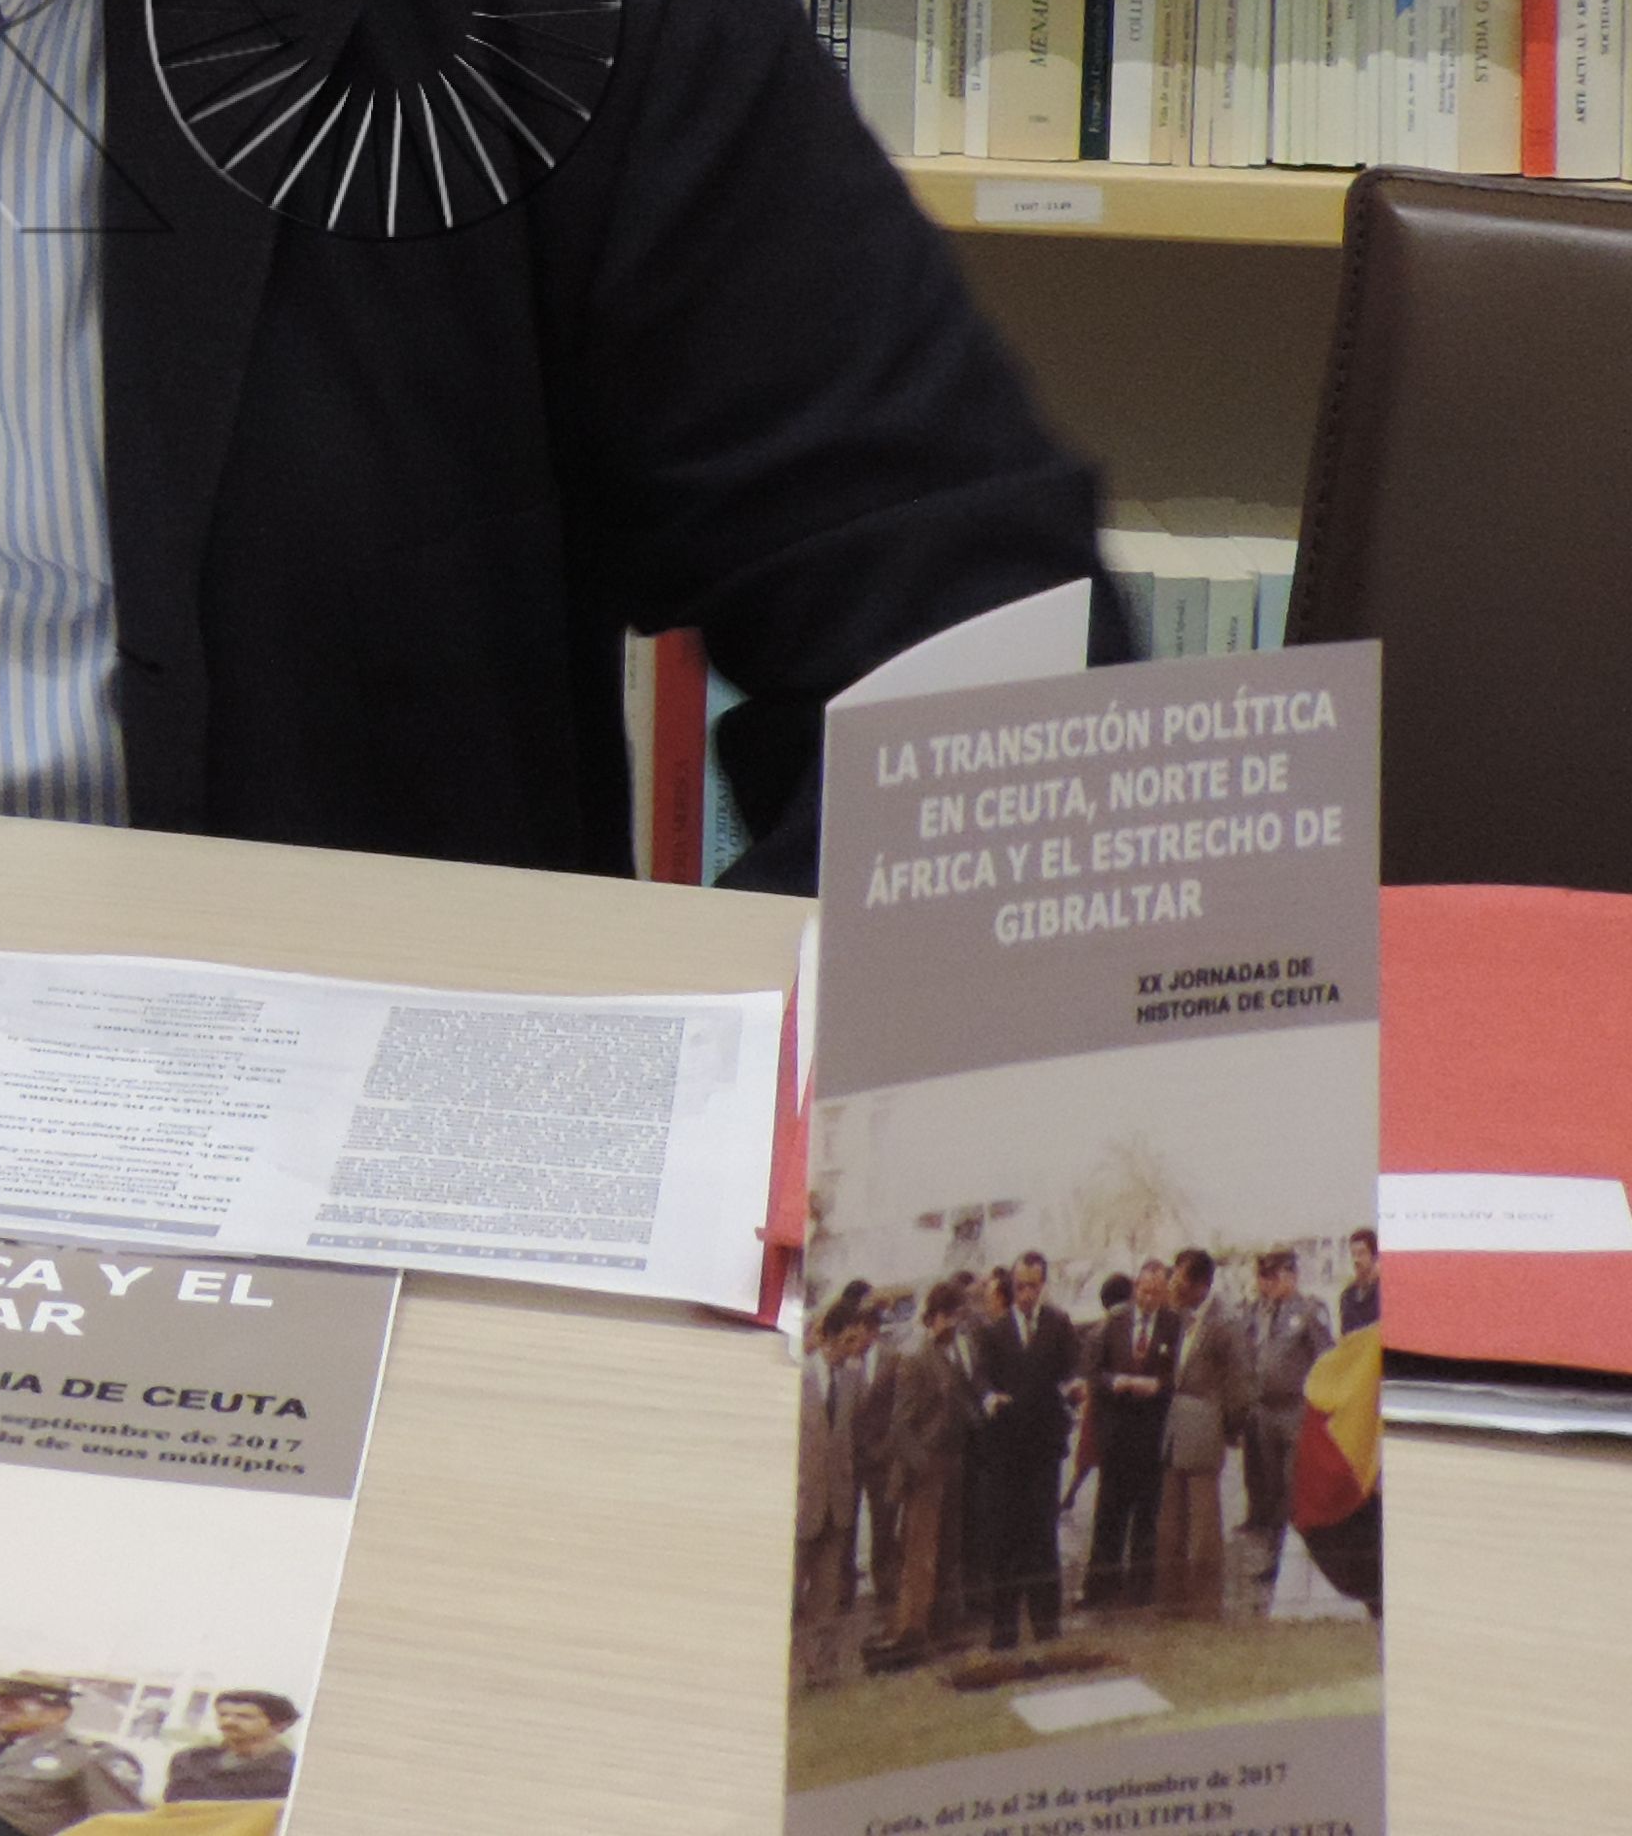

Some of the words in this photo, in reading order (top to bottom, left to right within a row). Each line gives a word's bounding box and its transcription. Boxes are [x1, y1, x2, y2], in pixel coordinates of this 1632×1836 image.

[877, 741, 919, 787] LA
[929, 702, 1151, 777] TRANSICIÓN
[1162, 686, 1337, 745] POLÍTICA
[919, 794, 964, 839] EN
[975, 777, 1097, 829] CEUTA,
[1109, 758, 1229, 811] NORTE
[1241, 752, 1288, 796] DE
[866, 849, 997, 909] ÁFRICA
[1006, 842, 1032, 883] Y
[1040, 836, 1082, 880] EL
[1091, 811, 1283, 872] ESTRECHO
[1294, 806, 1342, 848] DE
[995, 878, 1203, 945] GIBRALTAR
[1137, 973, 1163, 995] XX
[1168, 960, 1280, 992] JORNADAS
[1286, 957, 1312, 979] DE
[1137, 995, 1231, 1024] HISTORIA
[1237, 990, 1265, 1012] DE
[1270, 983, 1340, 1009] CEUTA
[98, 1263, 154, 1297] Y
[177, 1269, 274, 1309] EL
[59, 1376, 129, 1404] DE
[141, 1384, 309, 1421] CEUTA
[1, 1406, 171, 1444] septiembre
[180, 1427, 220, 1447] de
[226, 1431, 304, 1454] 2017
